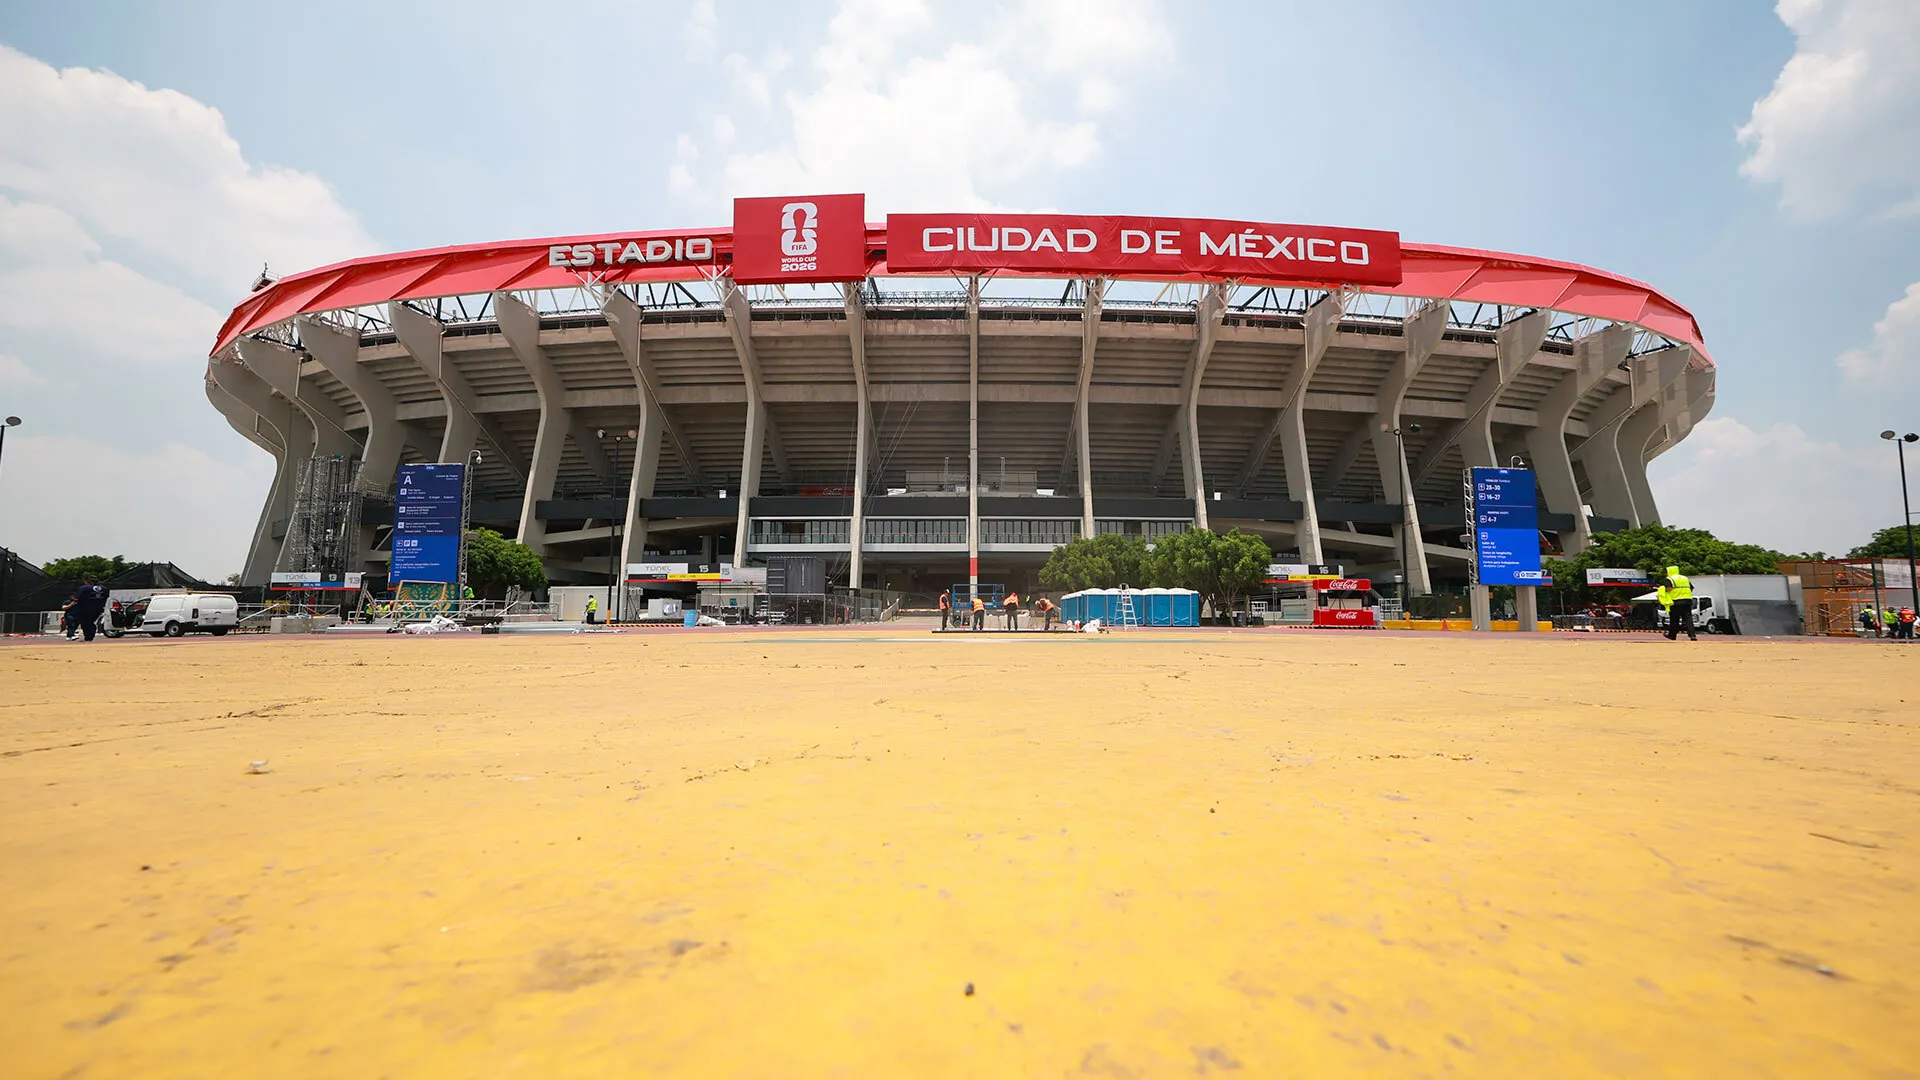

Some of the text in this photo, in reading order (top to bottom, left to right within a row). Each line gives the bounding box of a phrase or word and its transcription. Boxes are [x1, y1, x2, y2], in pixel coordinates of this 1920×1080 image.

[922, 227, 1370, 266] CIUDAD DE MÉXICO
[549, 237, 713, 267] ESTADIO
[781, 263, 817, 272] 2026
[403, 475, 412, 485] A
[699, 565, 709, 573] 15
[721, 567, 730, 575] 15
[1319, 566, 1329, 574] 16
[328, 573, 337, 581] 13
[348, 576, 360, 584] 13
